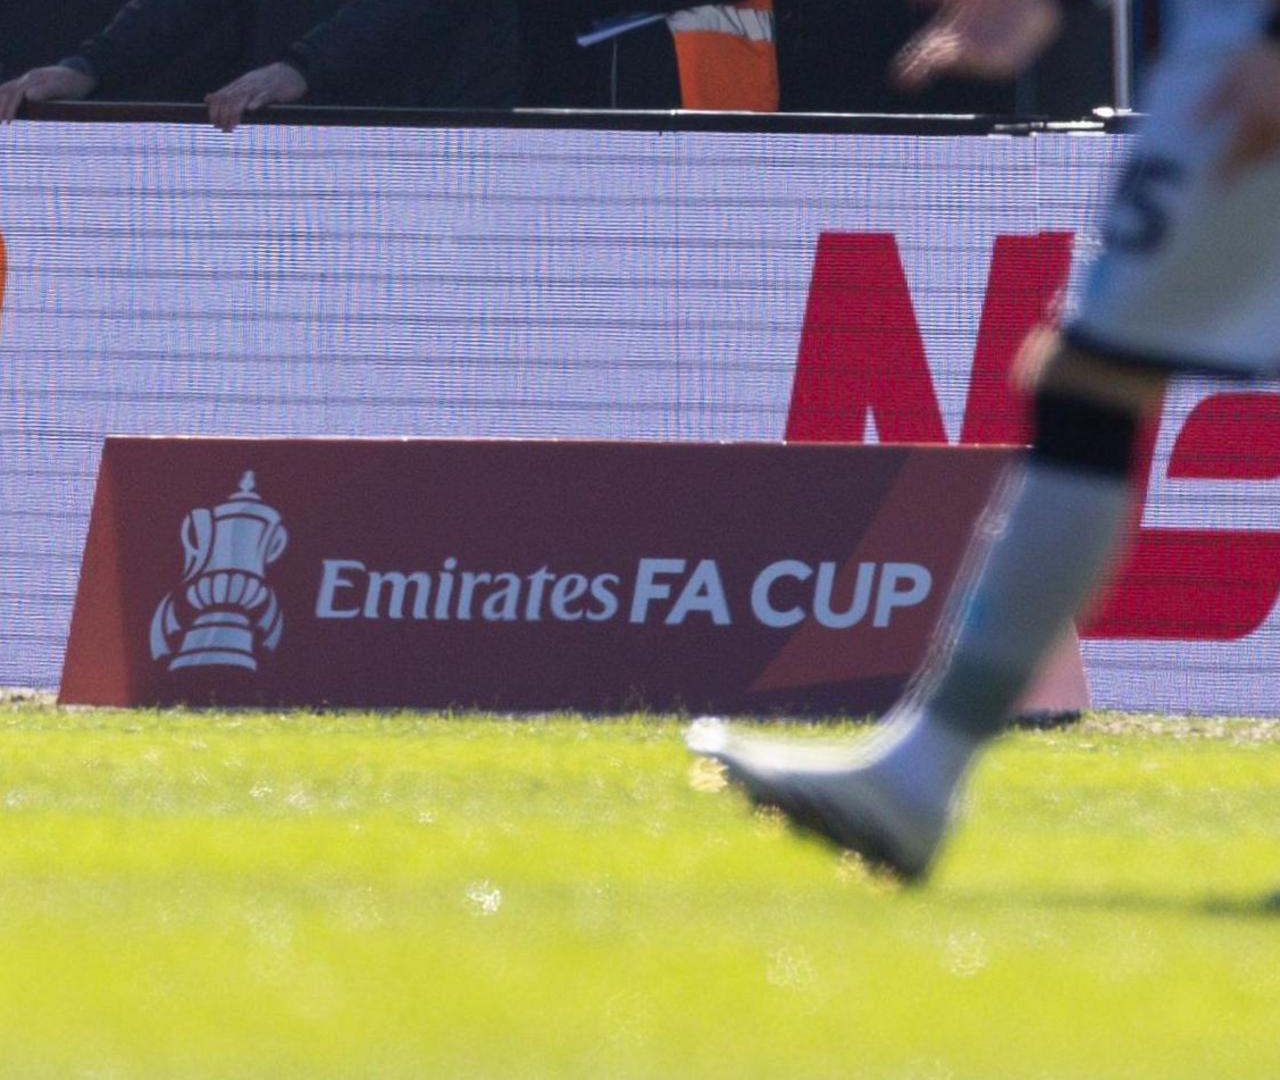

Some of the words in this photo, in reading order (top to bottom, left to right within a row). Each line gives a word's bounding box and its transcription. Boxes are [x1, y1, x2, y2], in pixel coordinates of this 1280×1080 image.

[315, 556, 620, 623] Emirates
[628, 558, 732, 626] FA
[750, 558, 933, 628] CUP
